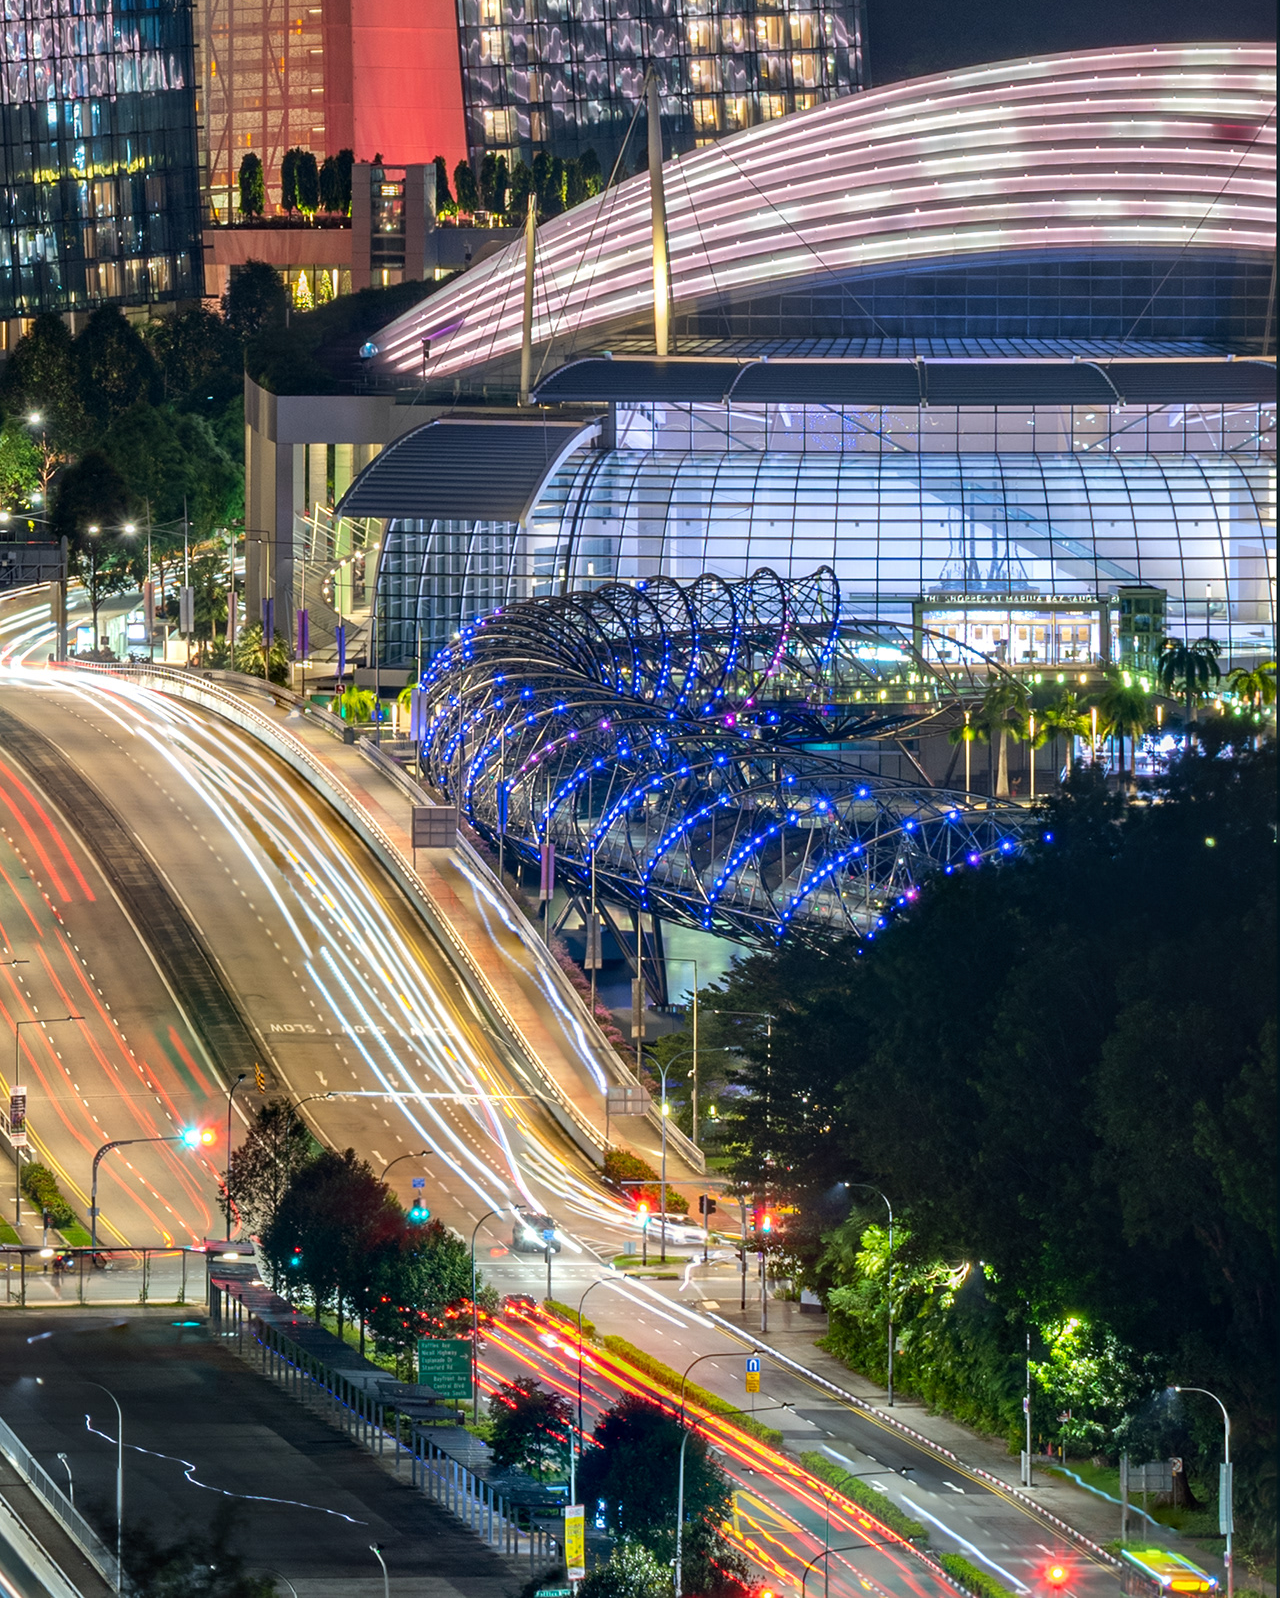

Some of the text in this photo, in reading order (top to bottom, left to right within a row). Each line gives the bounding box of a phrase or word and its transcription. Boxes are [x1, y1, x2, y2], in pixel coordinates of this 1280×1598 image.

[945, 594, 988, 603] SHOPPES
[991, 594, 1002, 603] AT
[1046, 595, 1063, 603] BAY
[270, 1023, 316, 1034] SLOW
